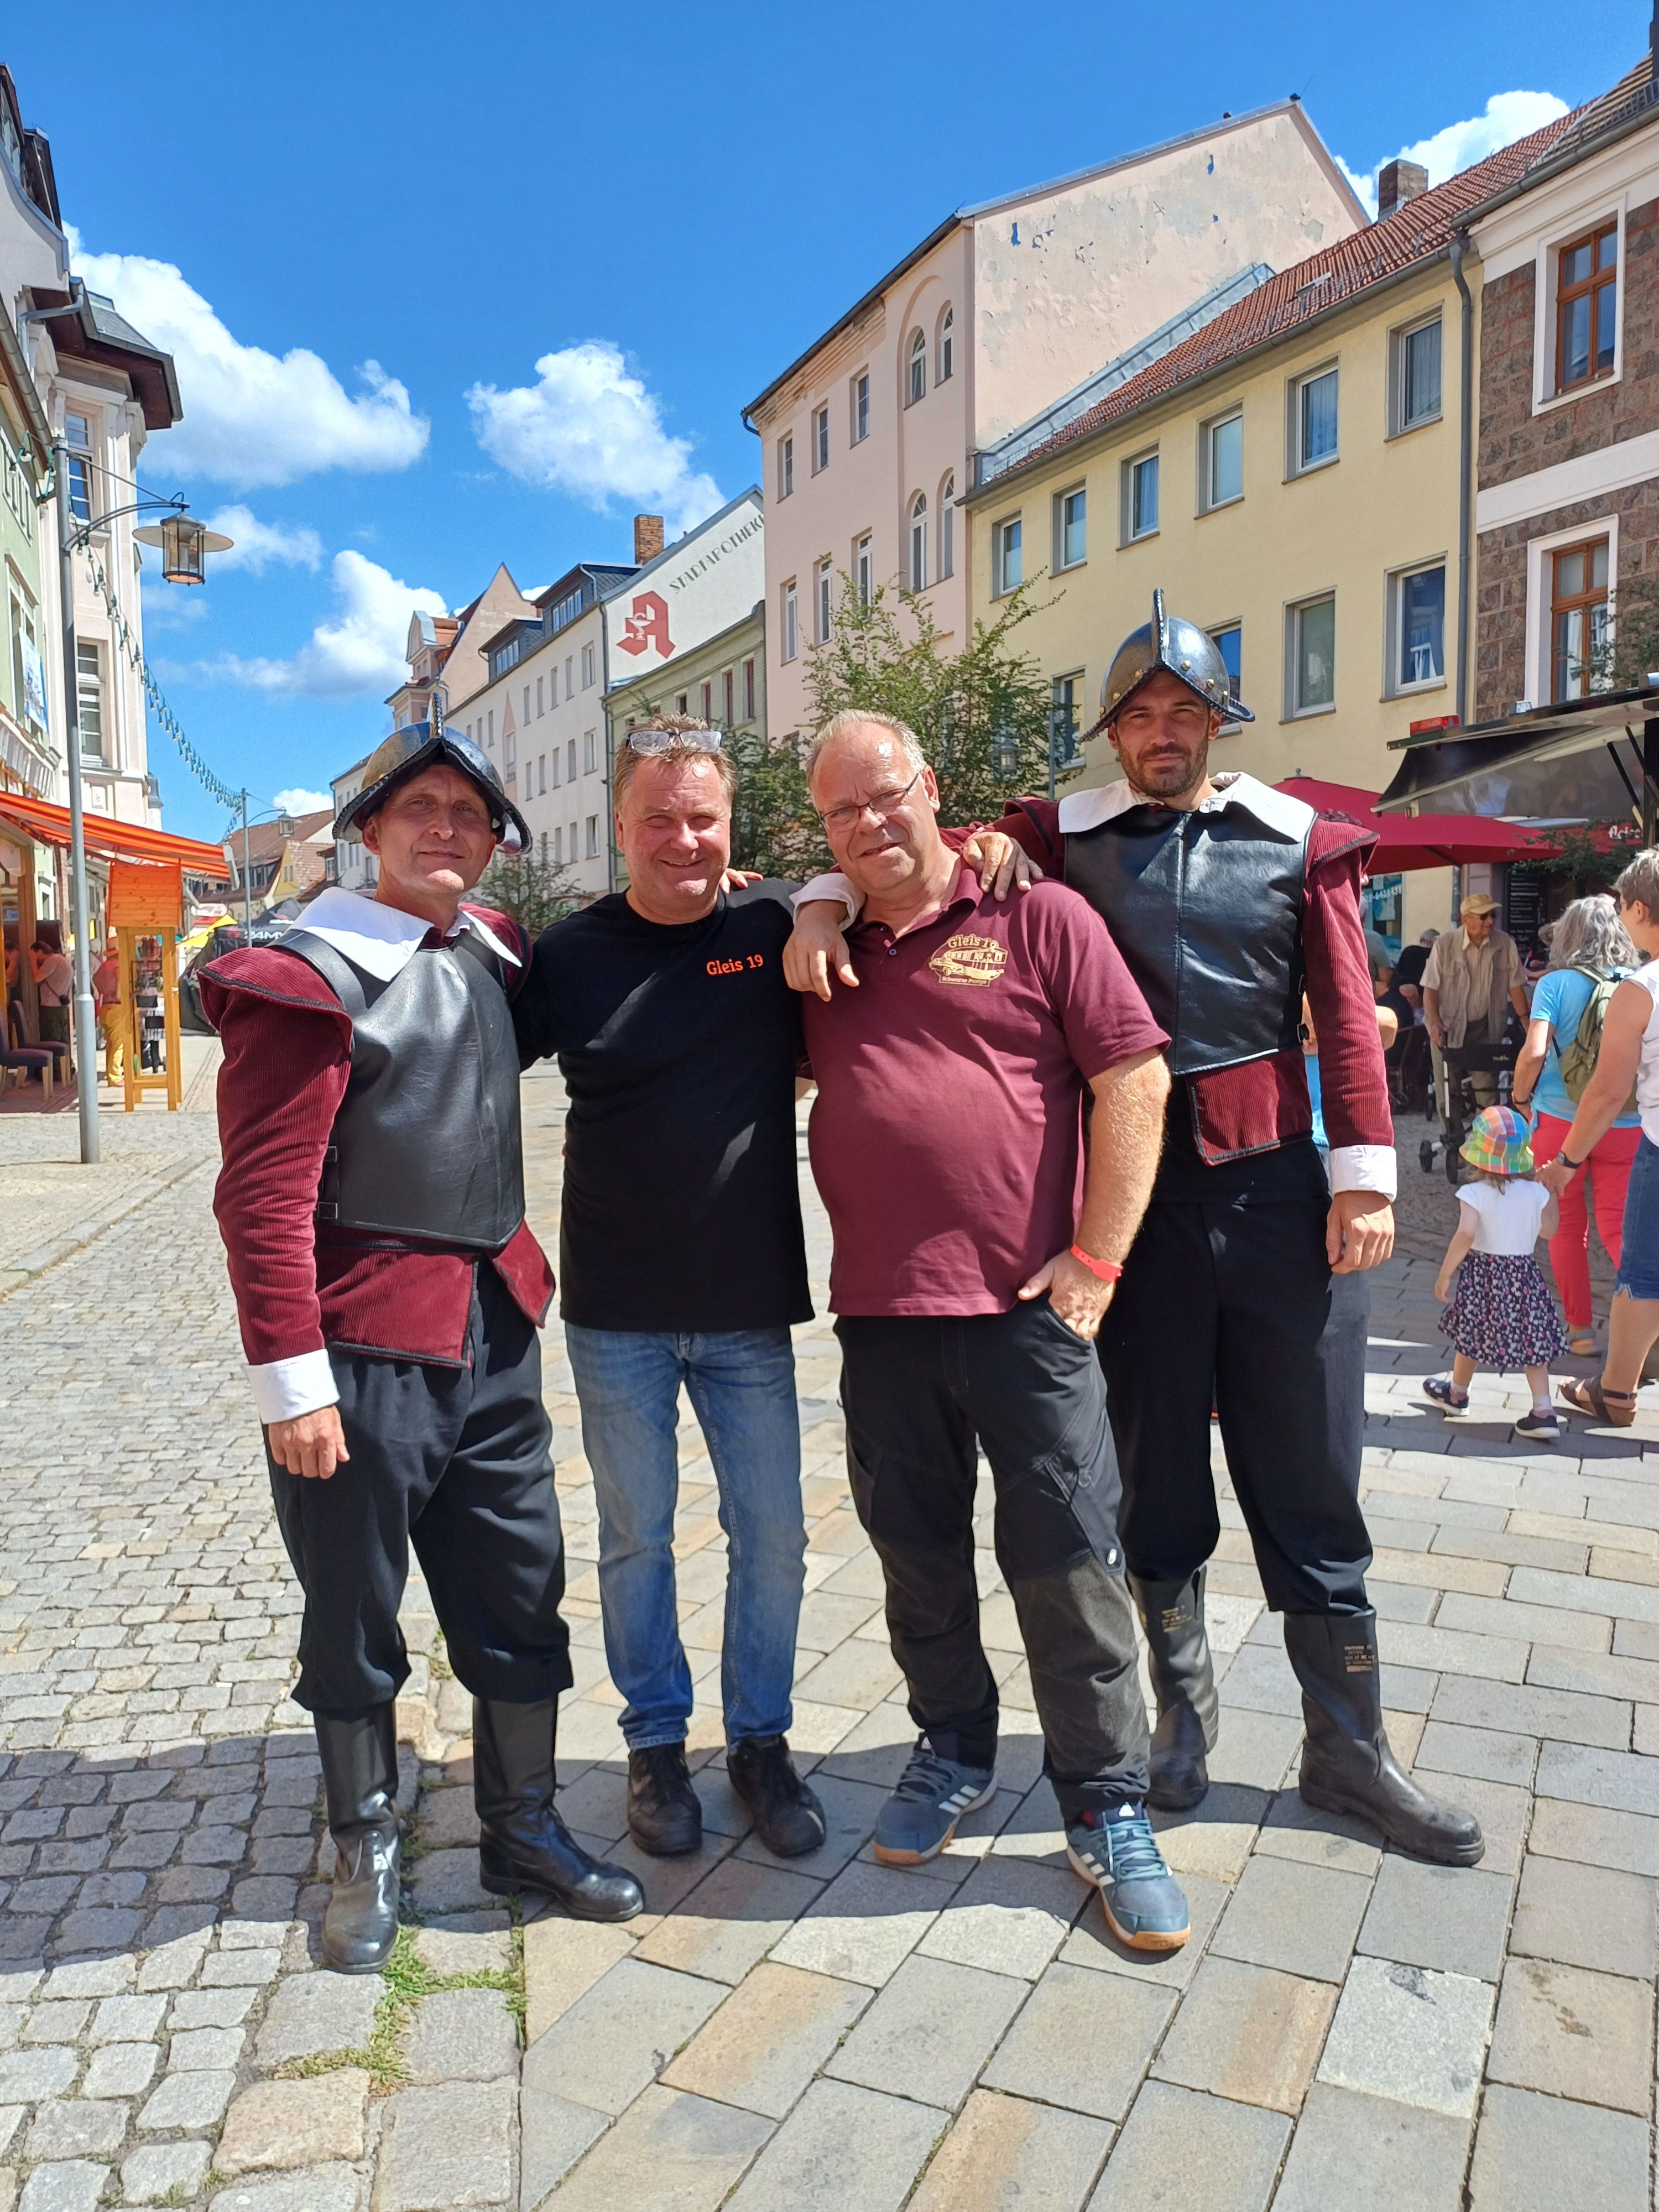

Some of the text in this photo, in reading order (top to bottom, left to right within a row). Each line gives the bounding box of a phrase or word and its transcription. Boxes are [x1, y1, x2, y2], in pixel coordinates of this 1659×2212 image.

[947, 933, 981, 948] Gleis
[706, 954, 764, 975] Gleis 19
